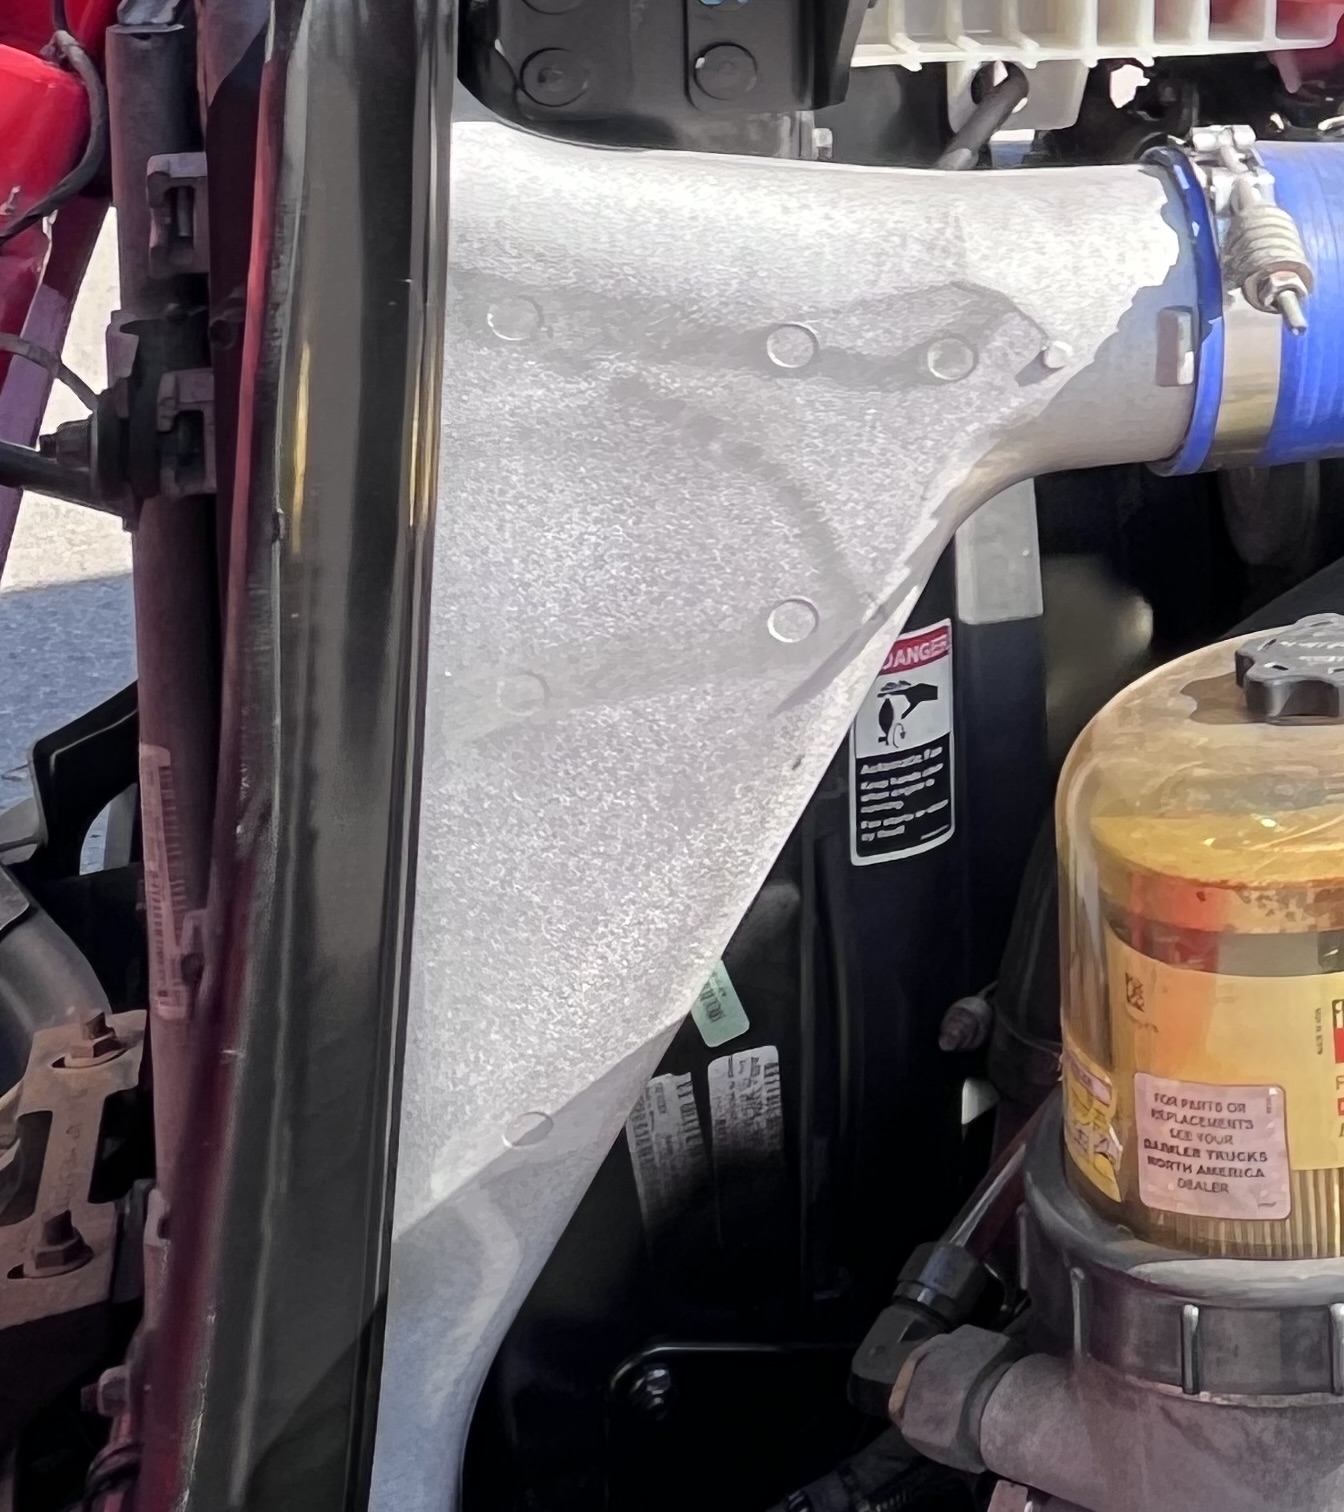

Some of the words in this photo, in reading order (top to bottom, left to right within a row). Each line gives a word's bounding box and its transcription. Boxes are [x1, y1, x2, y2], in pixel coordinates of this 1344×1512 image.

[1154, 1092, 1177, 1107] FOR
[1180, 1097, 1223, 1113] PARTS
[1226, 1101, 1247, 1114] OR
[1151, 1108, 1254, 1130] REPLACEMENTS
[1197, 1131, 1234, 1145] YOUR
[1206, 1148, 1268, 1163] TRUCKS
[1147, 1155, 1193, 1174] NORTH
[1196, 1164, 1266, 1178] AMERICA
[1177, 1177, 1230, 1194] DEALER
